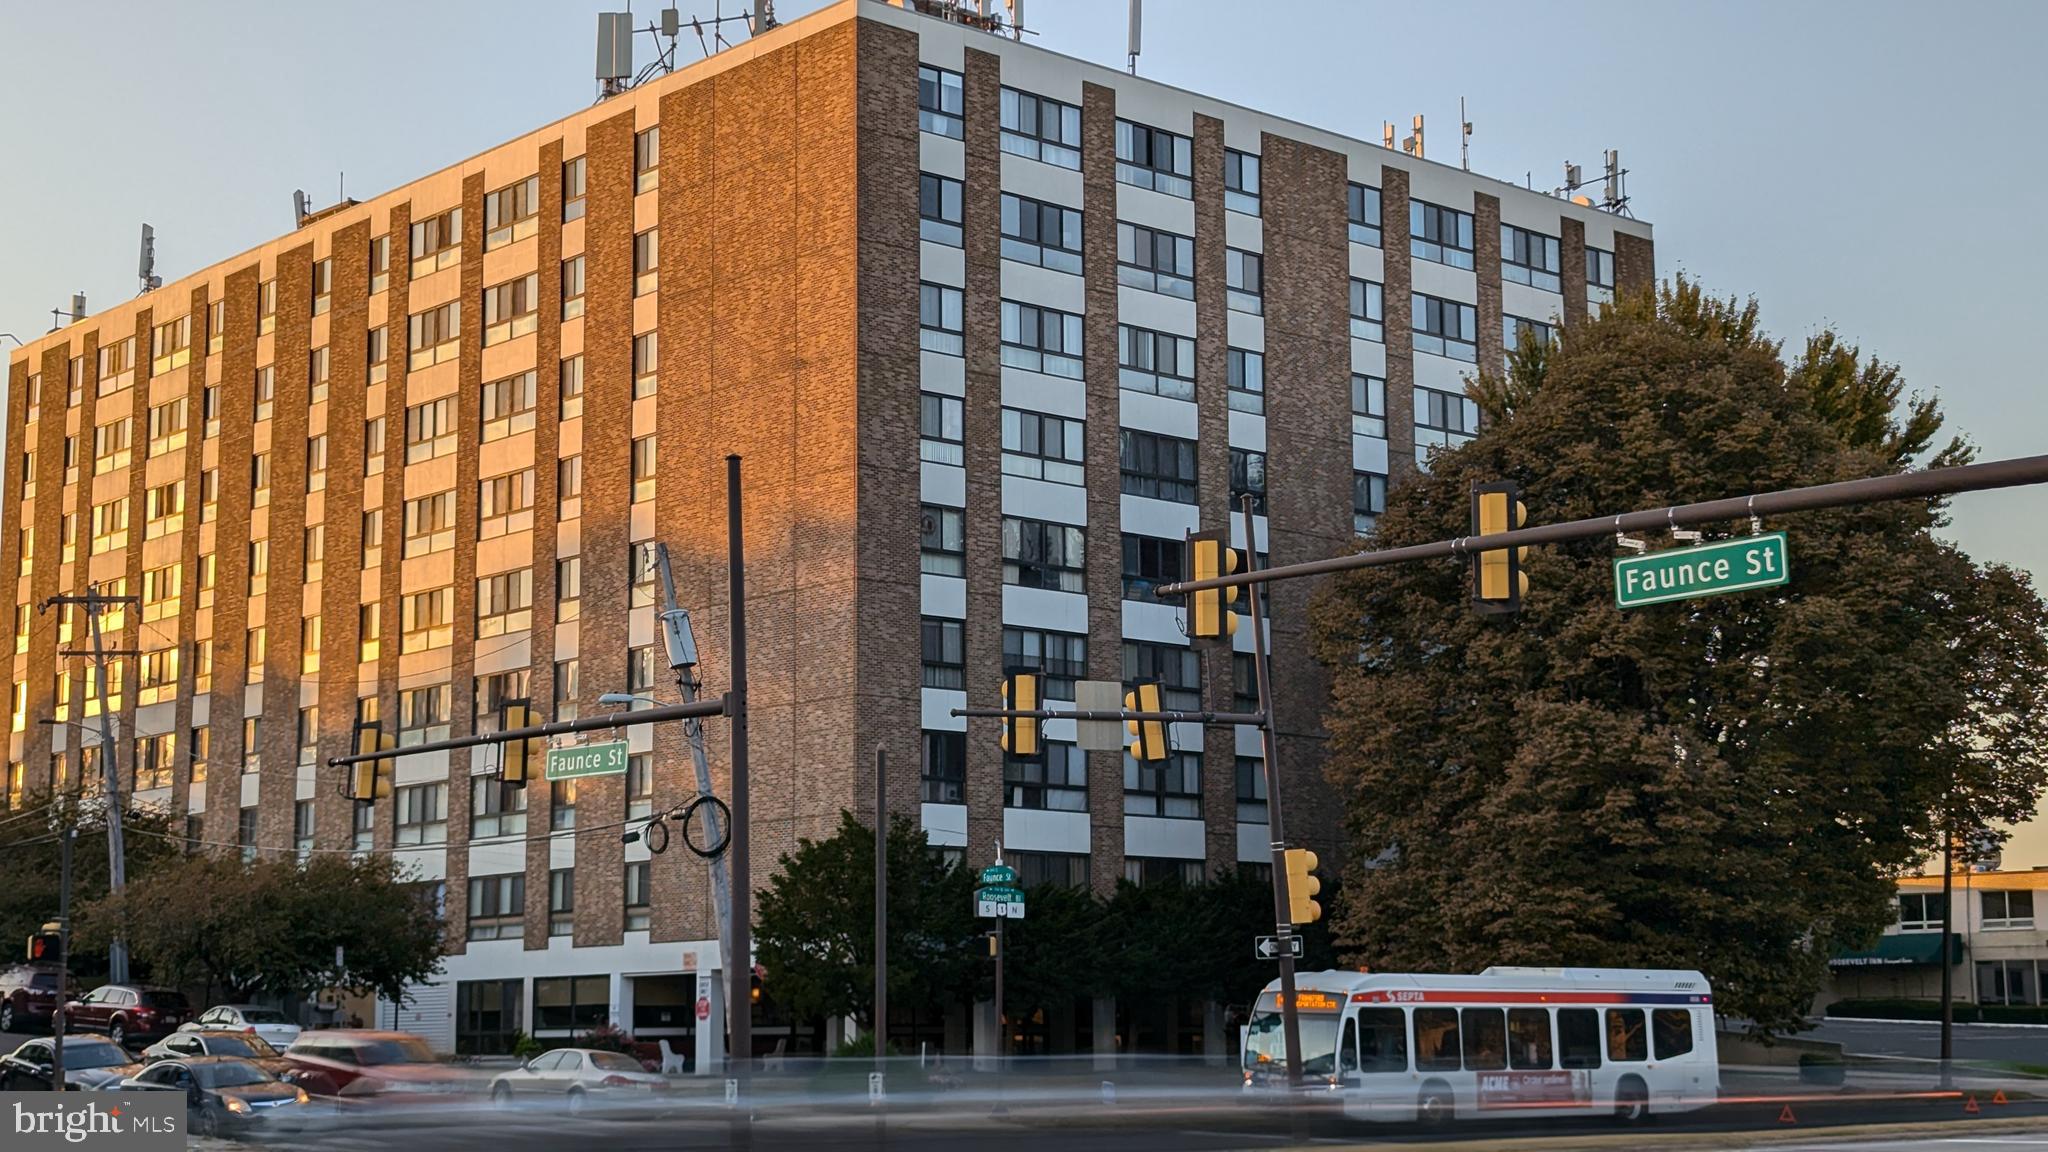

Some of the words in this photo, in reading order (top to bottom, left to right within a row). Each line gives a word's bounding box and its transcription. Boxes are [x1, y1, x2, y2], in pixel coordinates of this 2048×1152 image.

[1626, 558, 1730, 594] Faunce
[1745, 546, 1776, 575] St
[550, 753, 601, 772] Faunce
[608, 748, 623, 766] St
[983, 873, 1003, 882] Faunce
[982, 892, 1012, 902] Roosevelt
[1396, 991, 1425, 1001] SEPTA
[1481, 1075, 1510, 1092] ACME
[1522, 1075, 1542, 1085] Order
